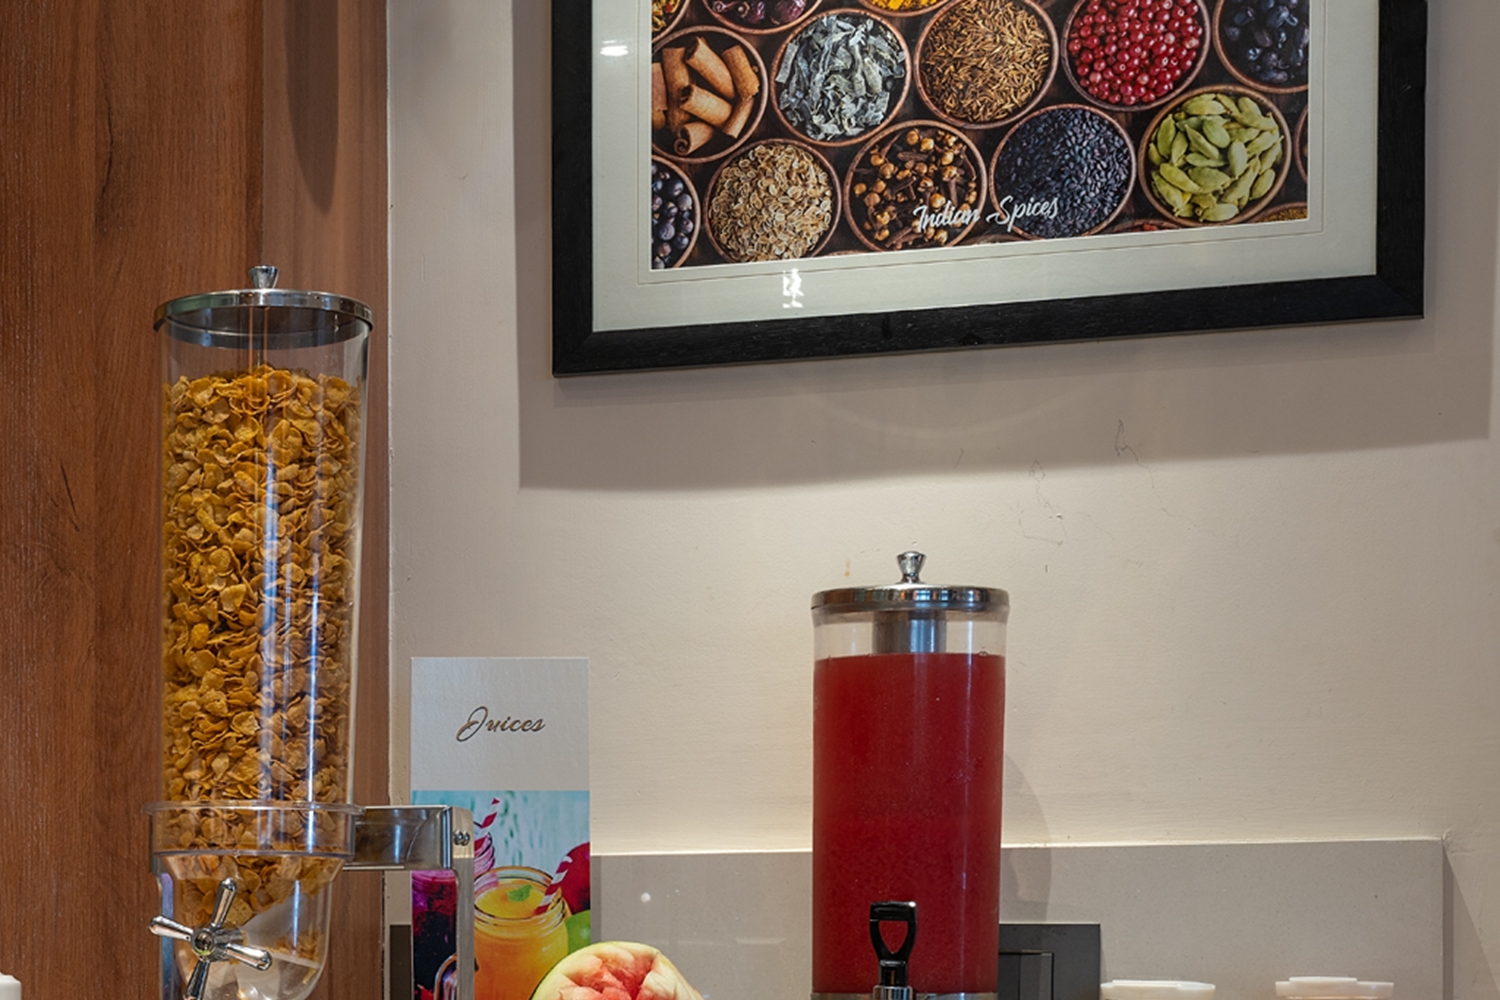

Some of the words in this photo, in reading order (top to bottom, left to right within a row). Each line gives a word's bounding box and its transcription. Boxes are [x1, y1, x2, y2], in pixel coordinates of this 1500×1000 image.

[913, 200, 980, 233] Indian
[986, 195, 1059, 233] Spices
[455, 705, 546, 742] Juices
